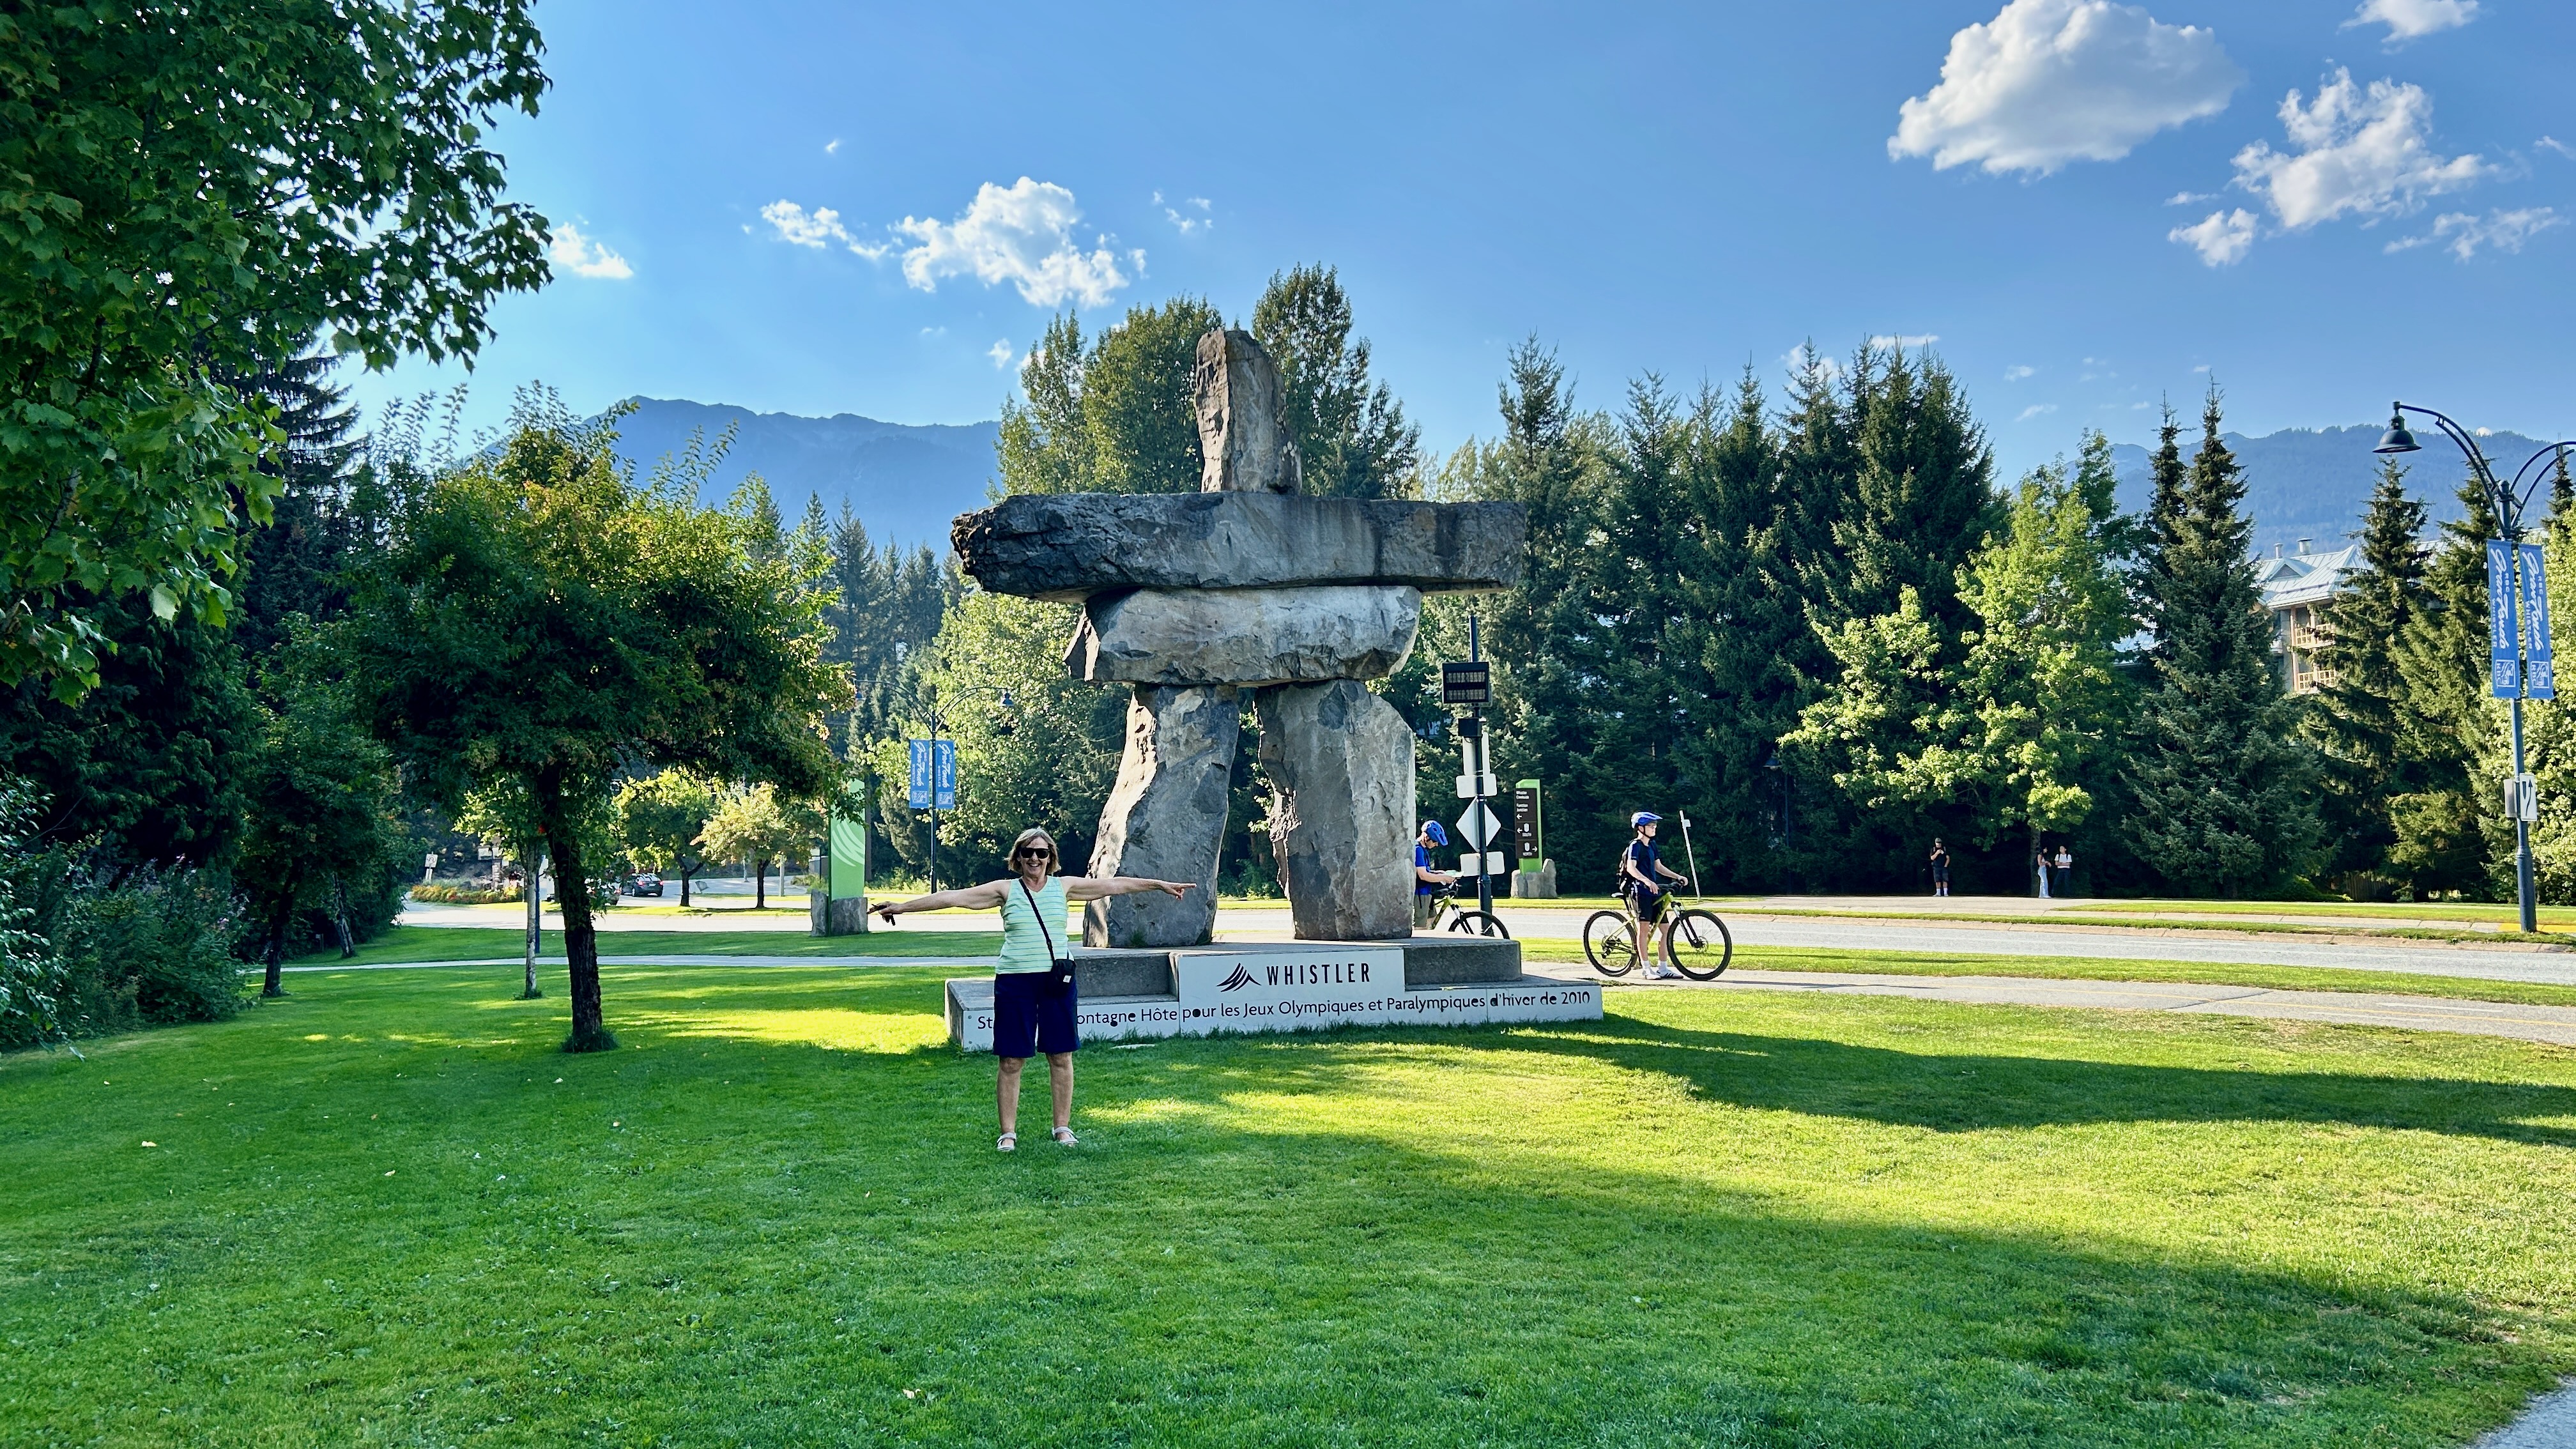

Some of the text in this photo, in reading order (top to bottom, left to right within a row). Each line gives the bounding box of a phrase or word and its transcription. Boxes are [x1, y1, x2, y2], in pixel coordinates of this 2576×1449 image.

[1266, 963, 1370, 986] WHISTLER
[1077, 991, 1590, 1027] ontagne Hôte pour les Jeux Olympiques et Paralympiques d'hiver de 2010
